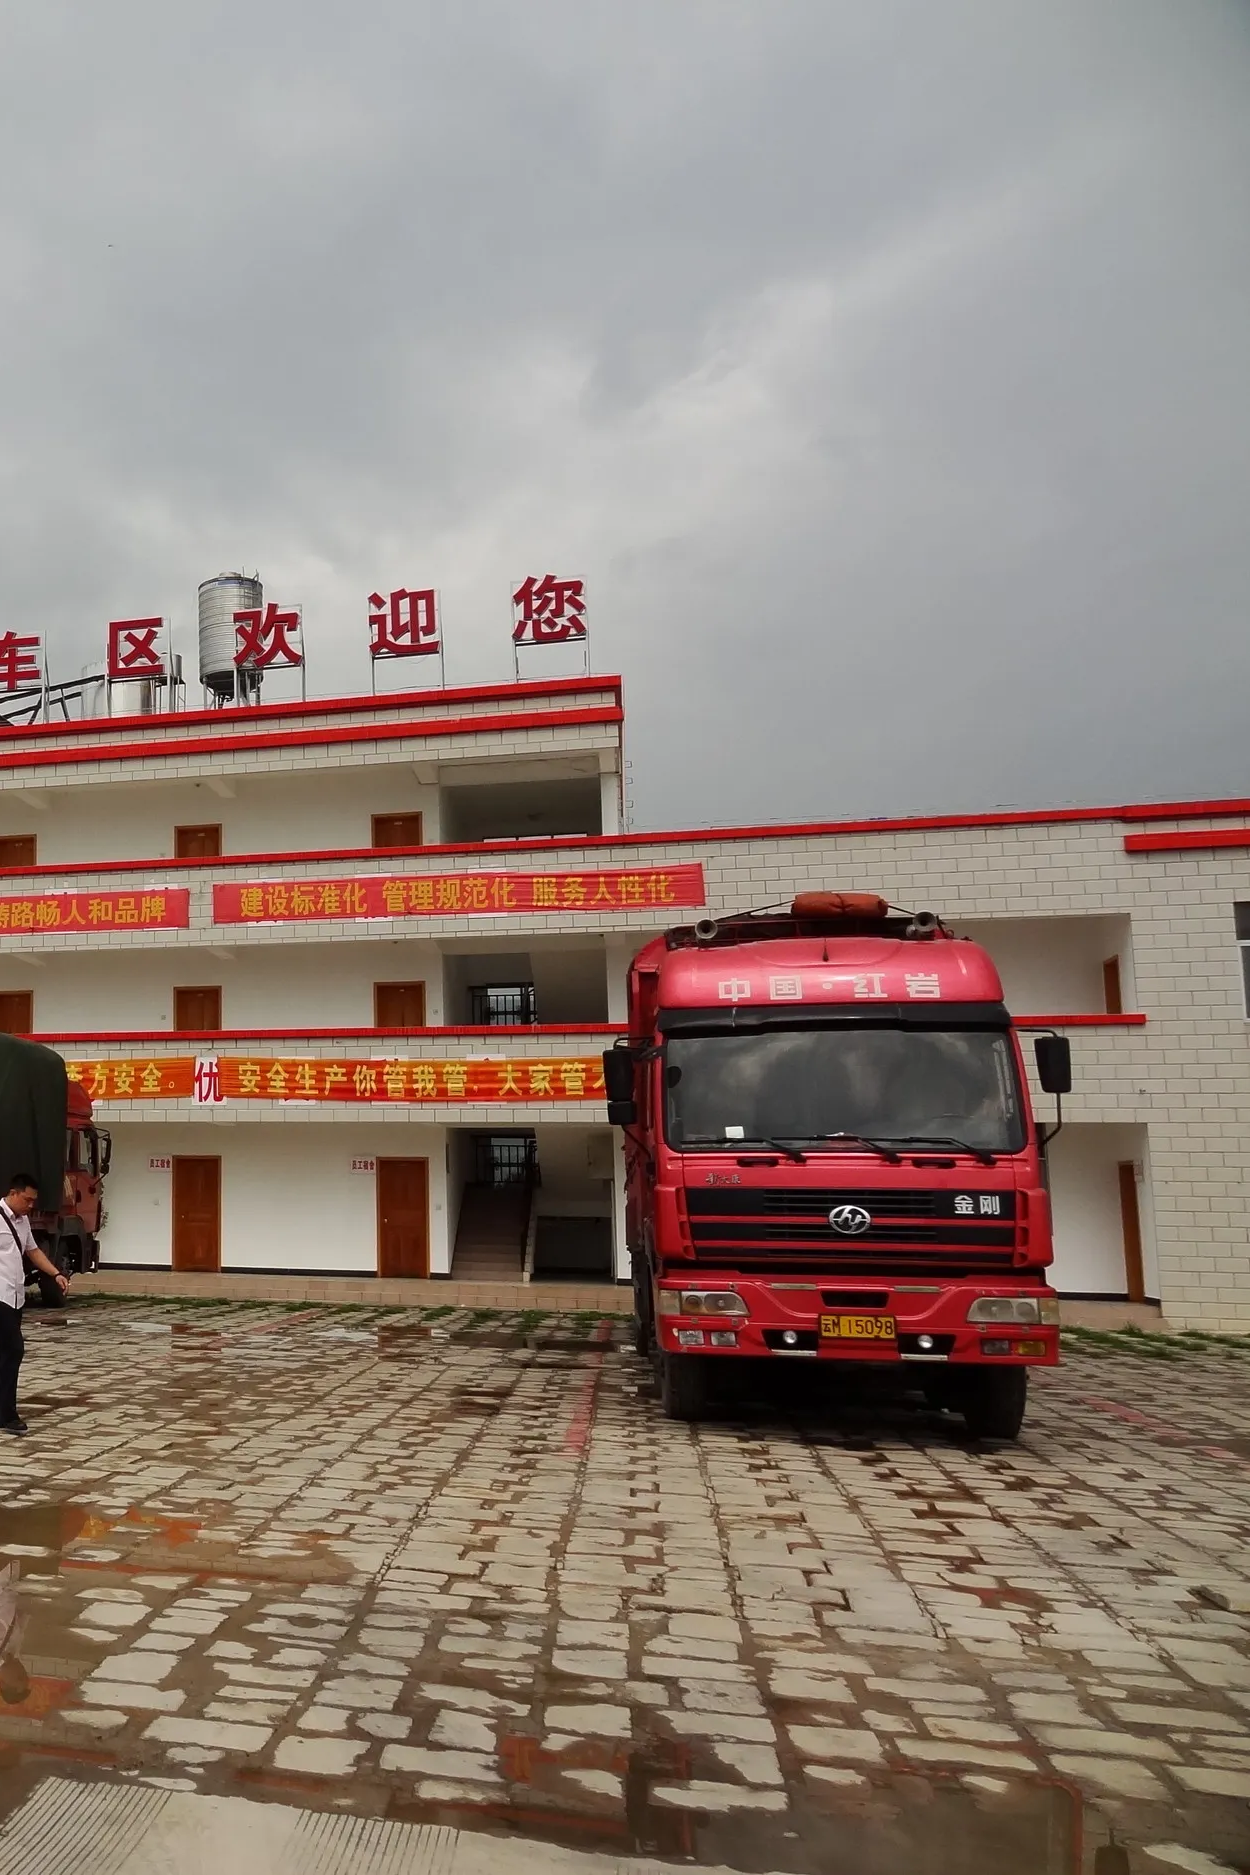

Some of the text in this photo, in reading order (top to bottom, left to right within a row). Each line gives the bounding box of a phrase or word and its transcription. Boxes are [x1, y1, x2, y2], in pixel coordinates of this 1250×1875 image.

[239, 871, 675, 918] 建设标准化 管理规范化 服务人性化
[954, 1194, 1001, 1215] 金刚
